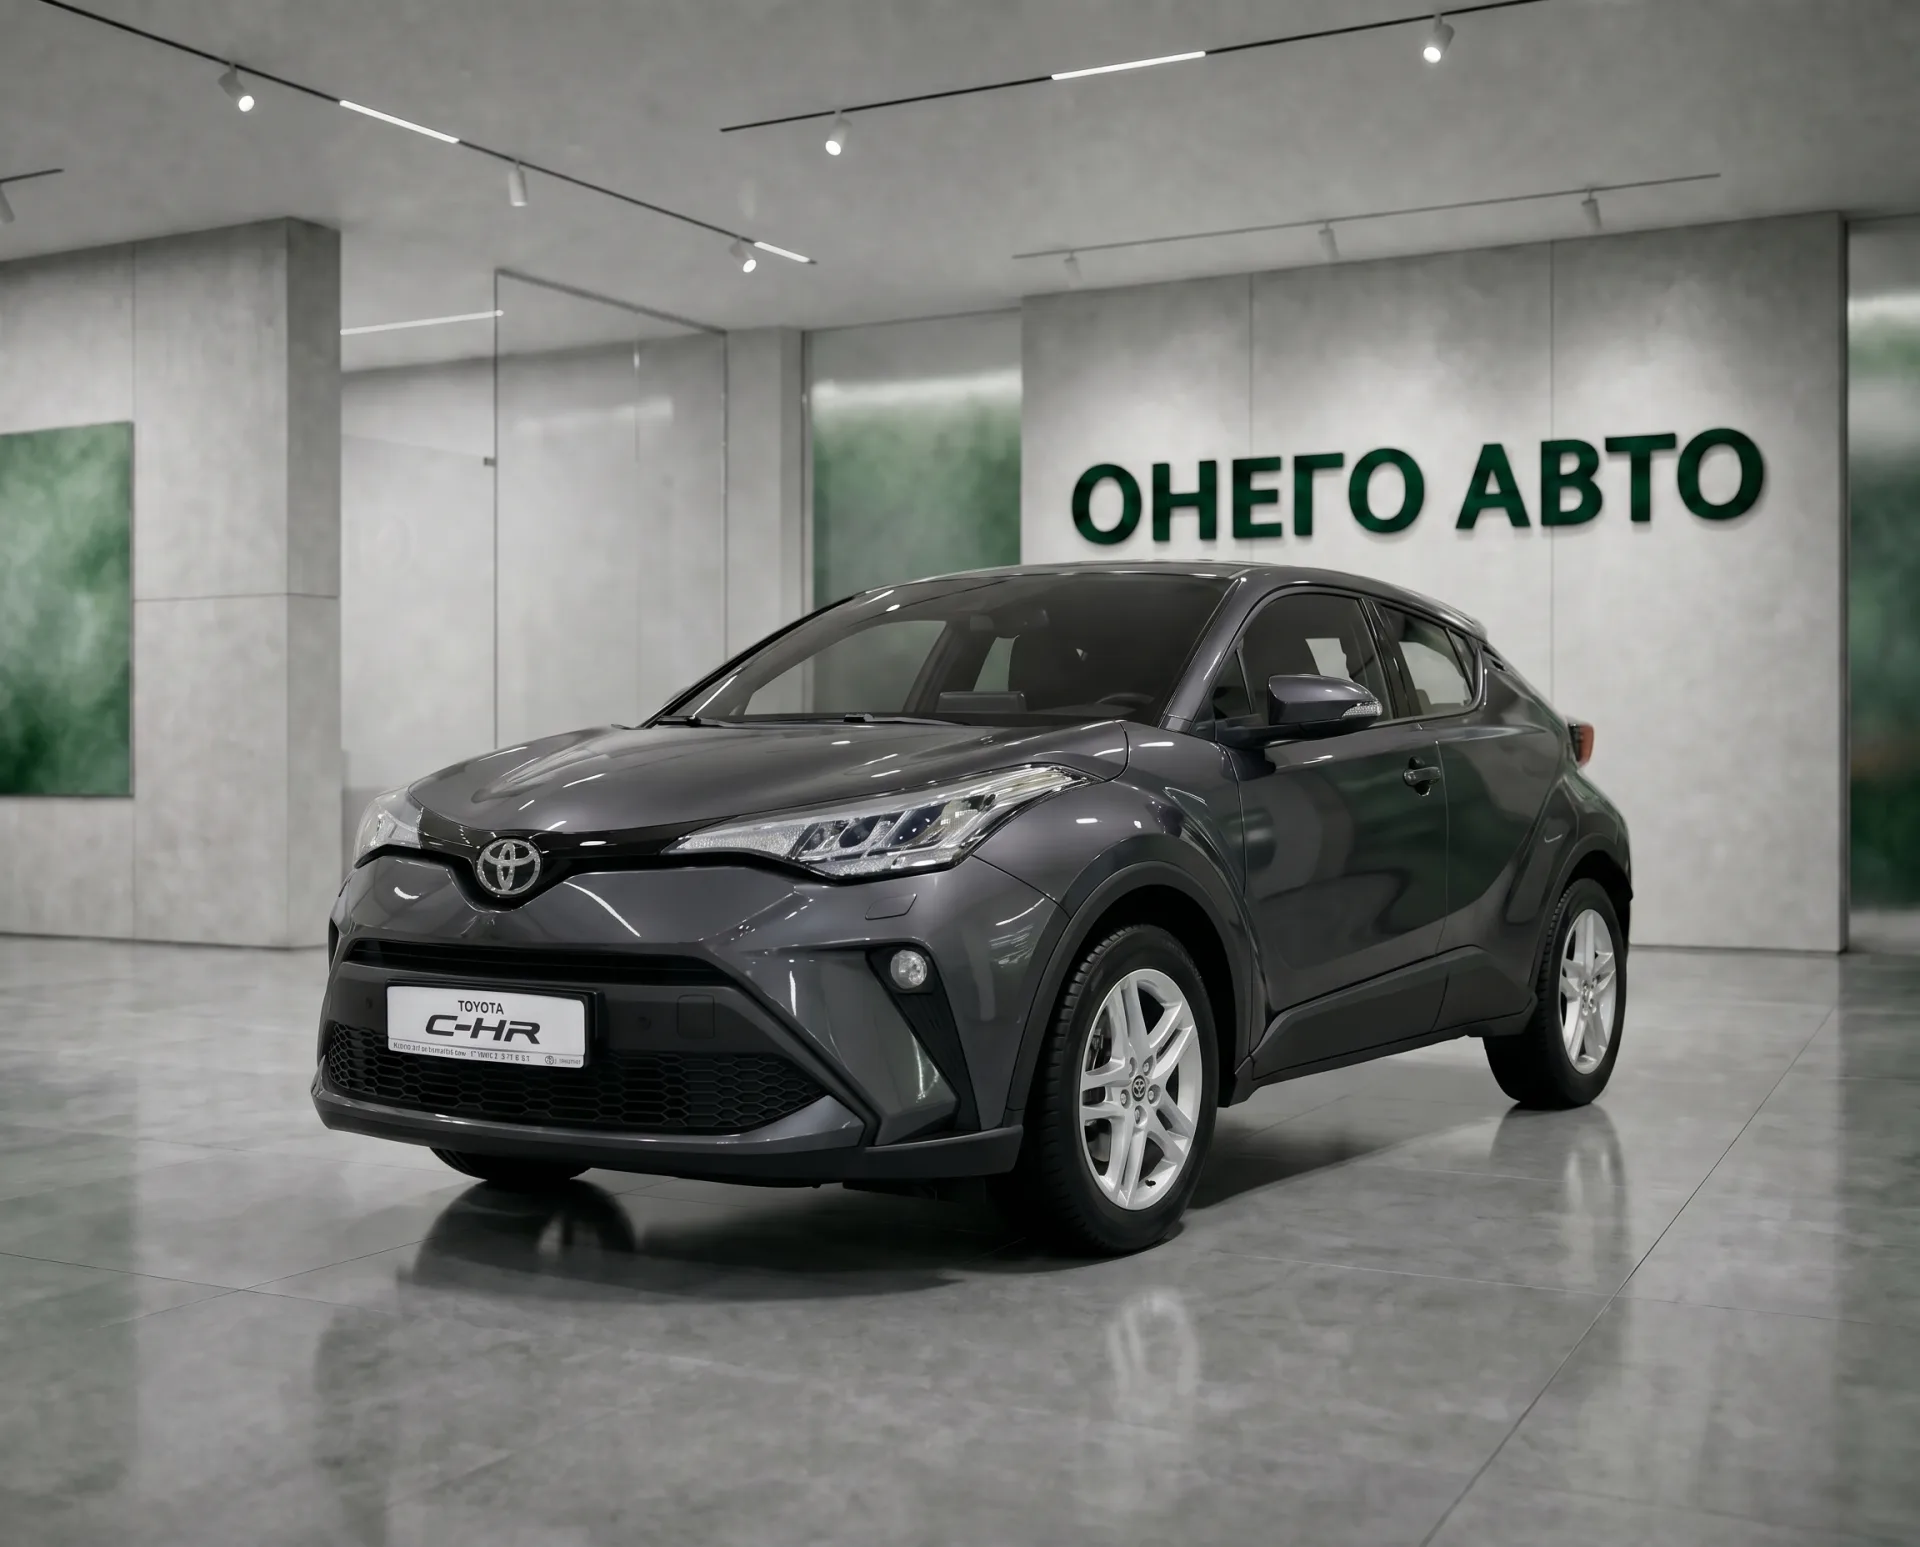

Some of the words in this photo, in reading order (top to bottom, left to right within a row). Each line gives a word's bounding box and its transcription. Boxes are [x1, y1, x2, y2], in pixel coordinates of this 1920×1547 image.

[1071, 447, 1425, 545] ОНЕГО
[1456, 427, 1765, 530] АВТО
[458, 1000, 504, 1015] TOYOTA
[425, 1014, 541, 1045] C-HR
